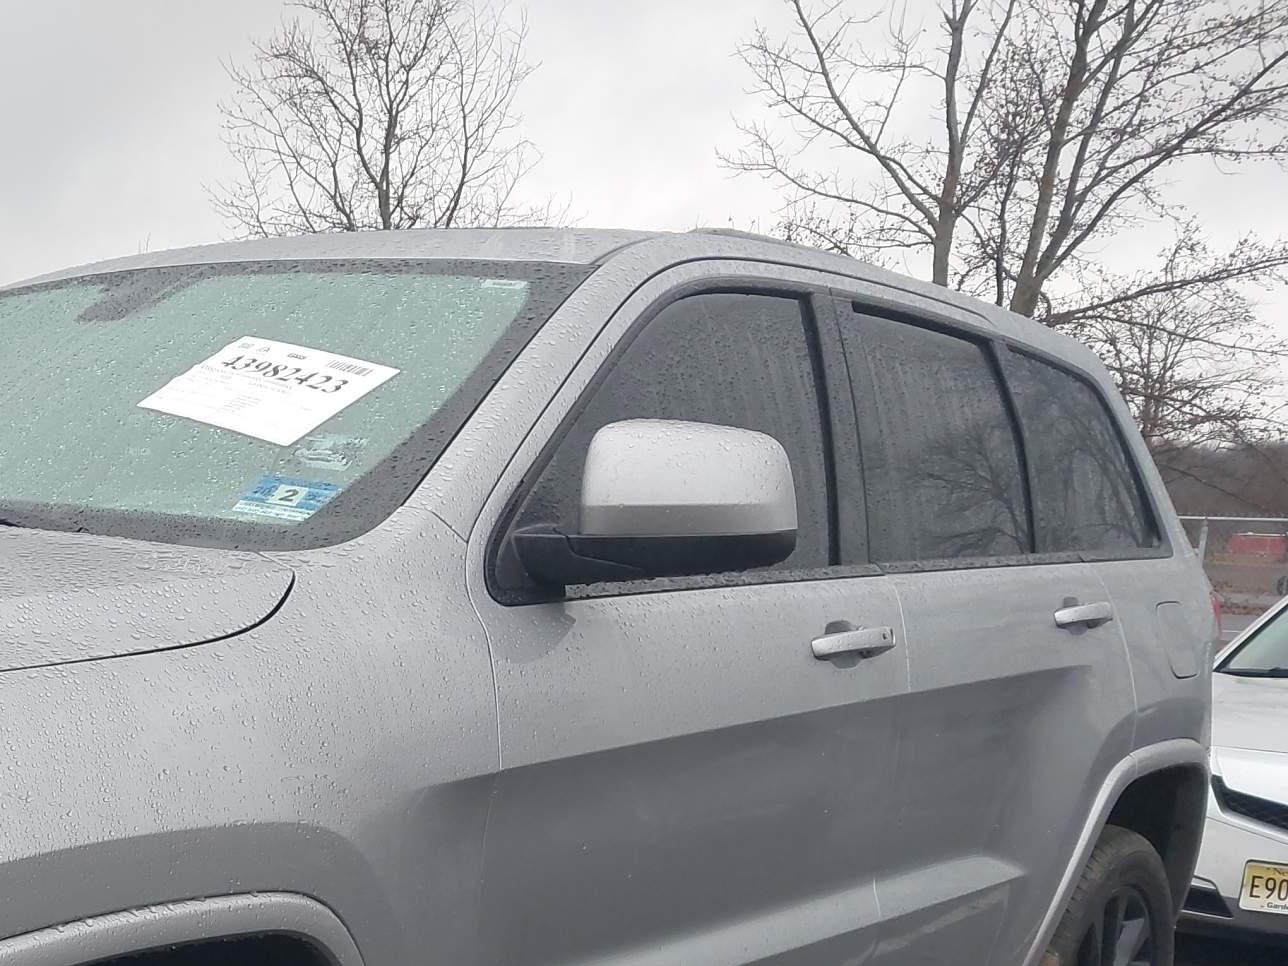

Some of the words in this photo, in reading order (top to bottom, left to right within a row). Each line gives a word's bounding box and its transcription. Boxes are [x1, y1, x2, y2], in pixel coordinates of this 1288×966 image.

[220, 355, 349, 394] 43982423
[279, 488, 300, 503] 2
[1248, 875, 1288, 901] E90
